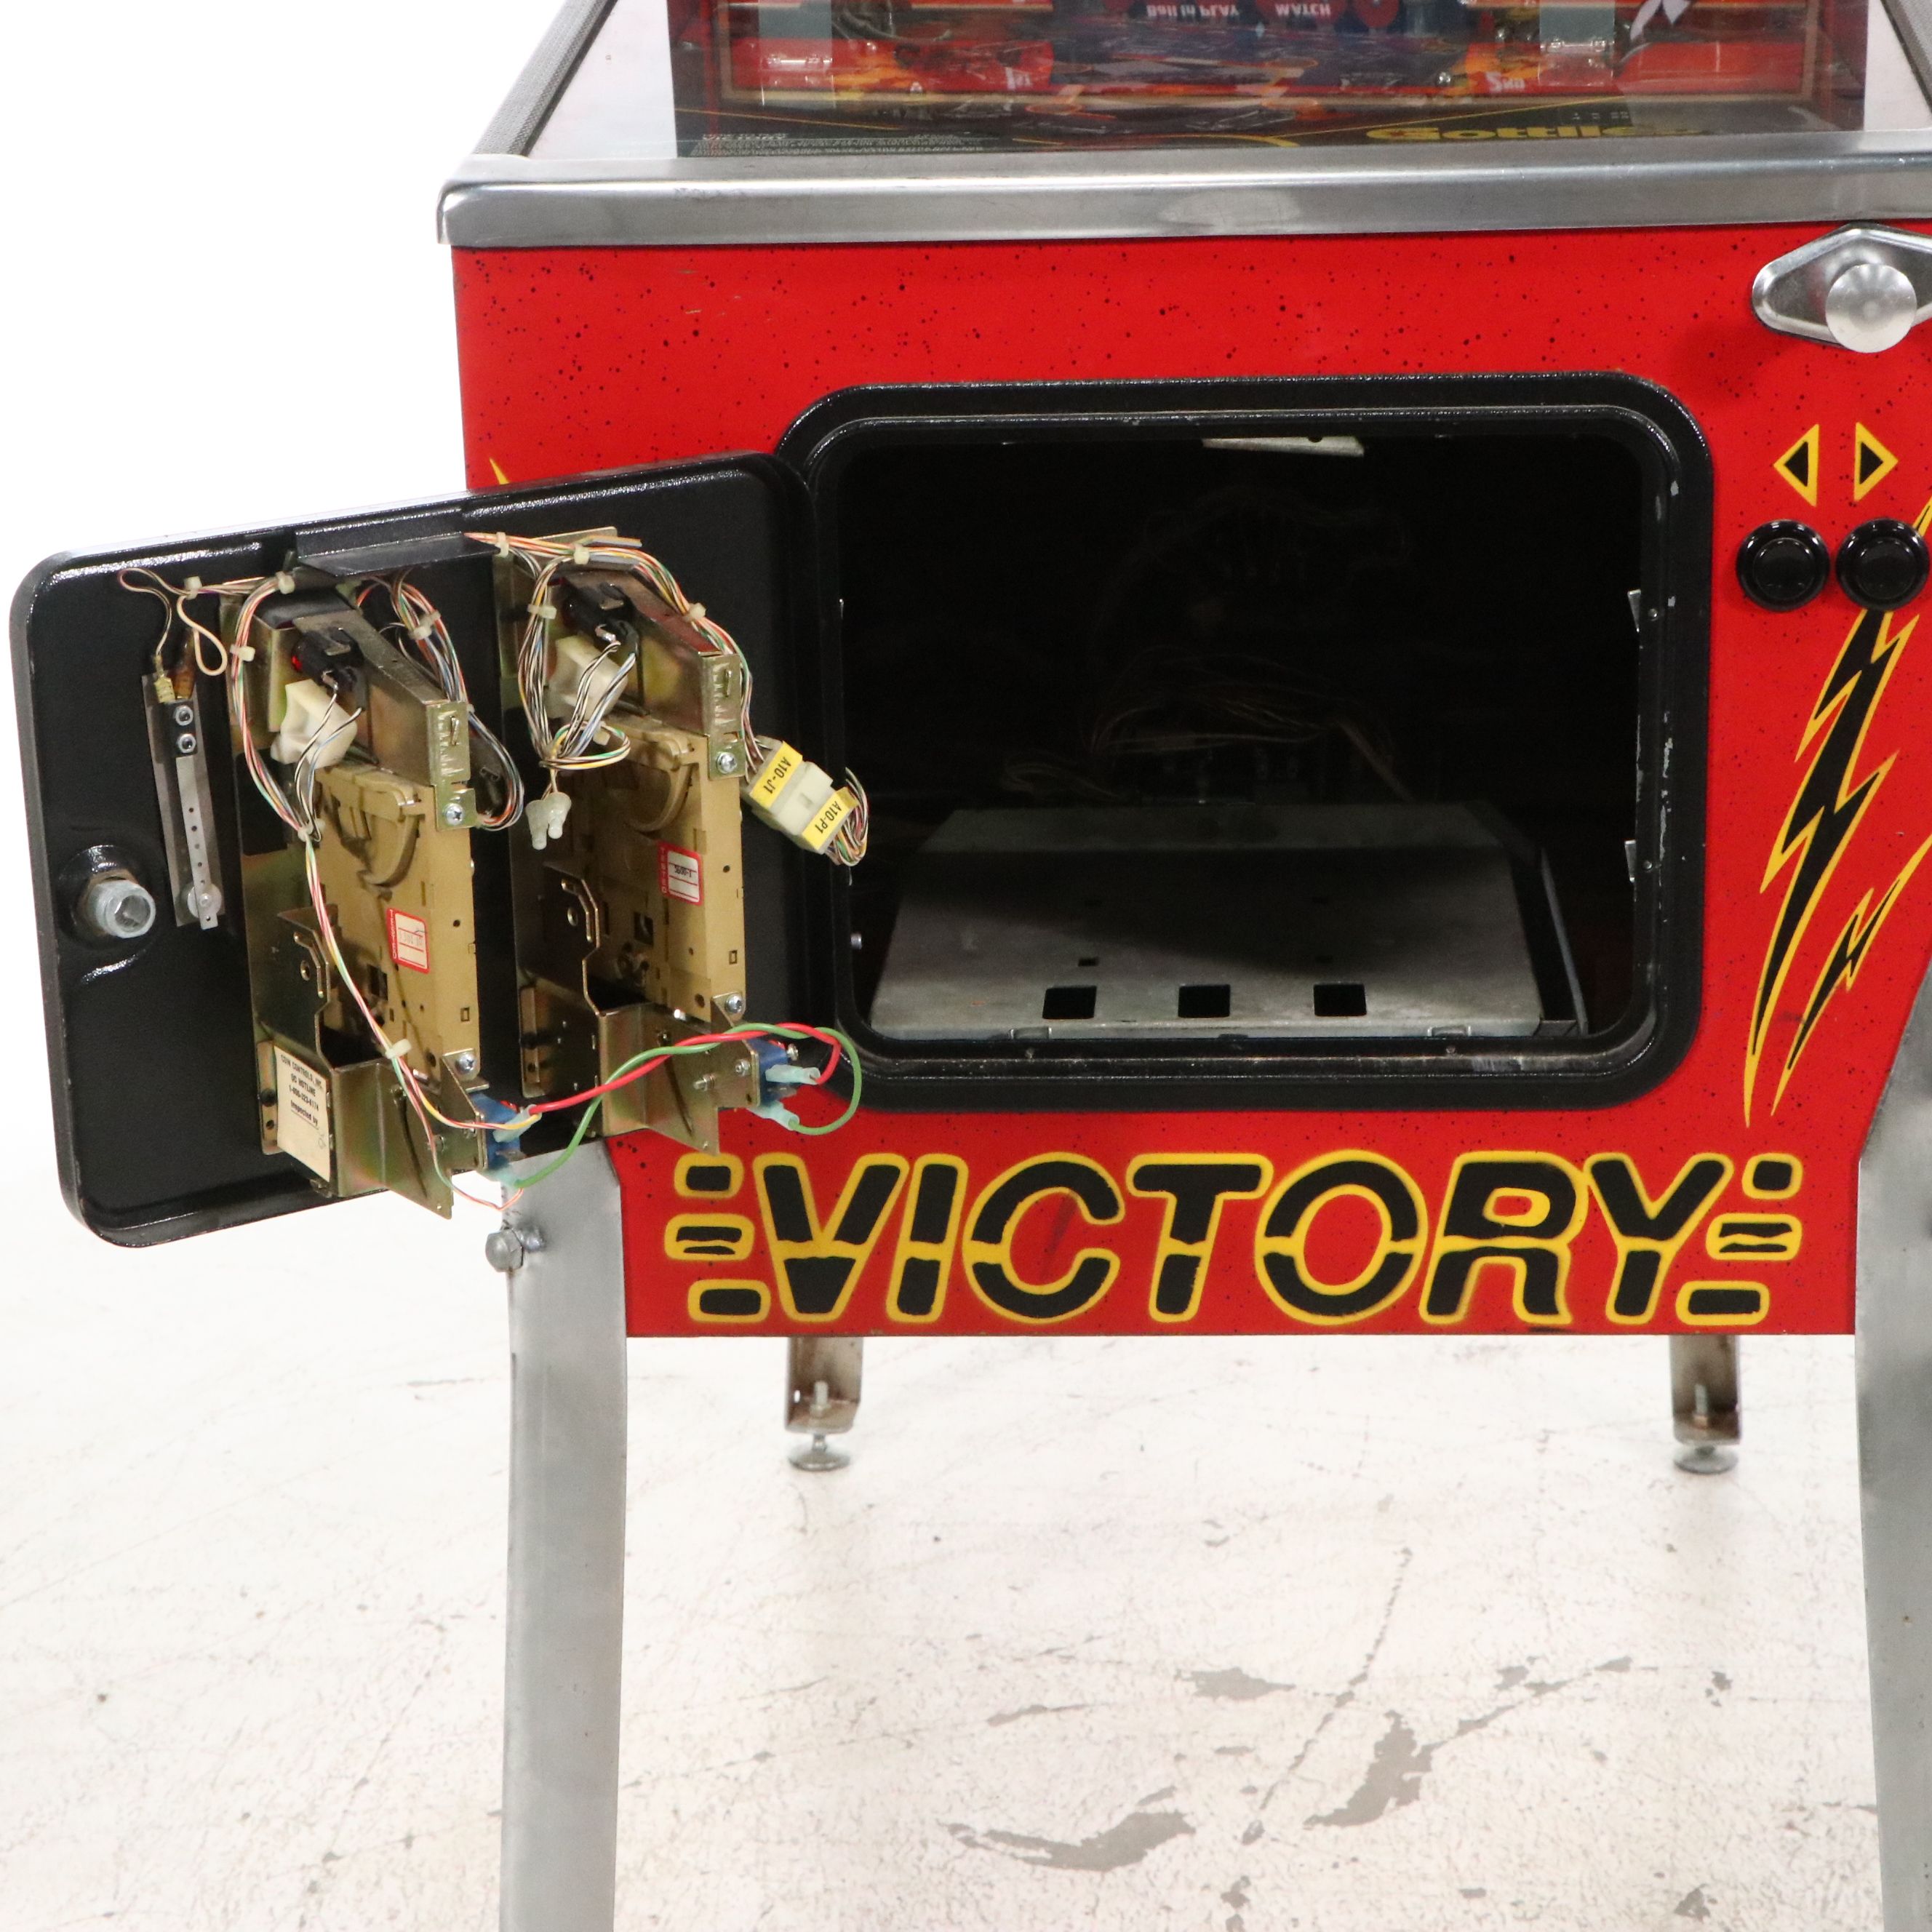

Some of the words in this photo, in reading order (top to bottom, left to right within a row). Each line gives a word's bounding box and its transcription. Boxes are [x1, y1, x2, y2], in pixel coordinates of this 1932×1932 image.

[762, 756, 792, 794] A10-J1
[815, 800, 842, 834] A10-P1
[389, 909, 397, 959] TESTED
[753, 1150, 1733, 1325] VICTORY
